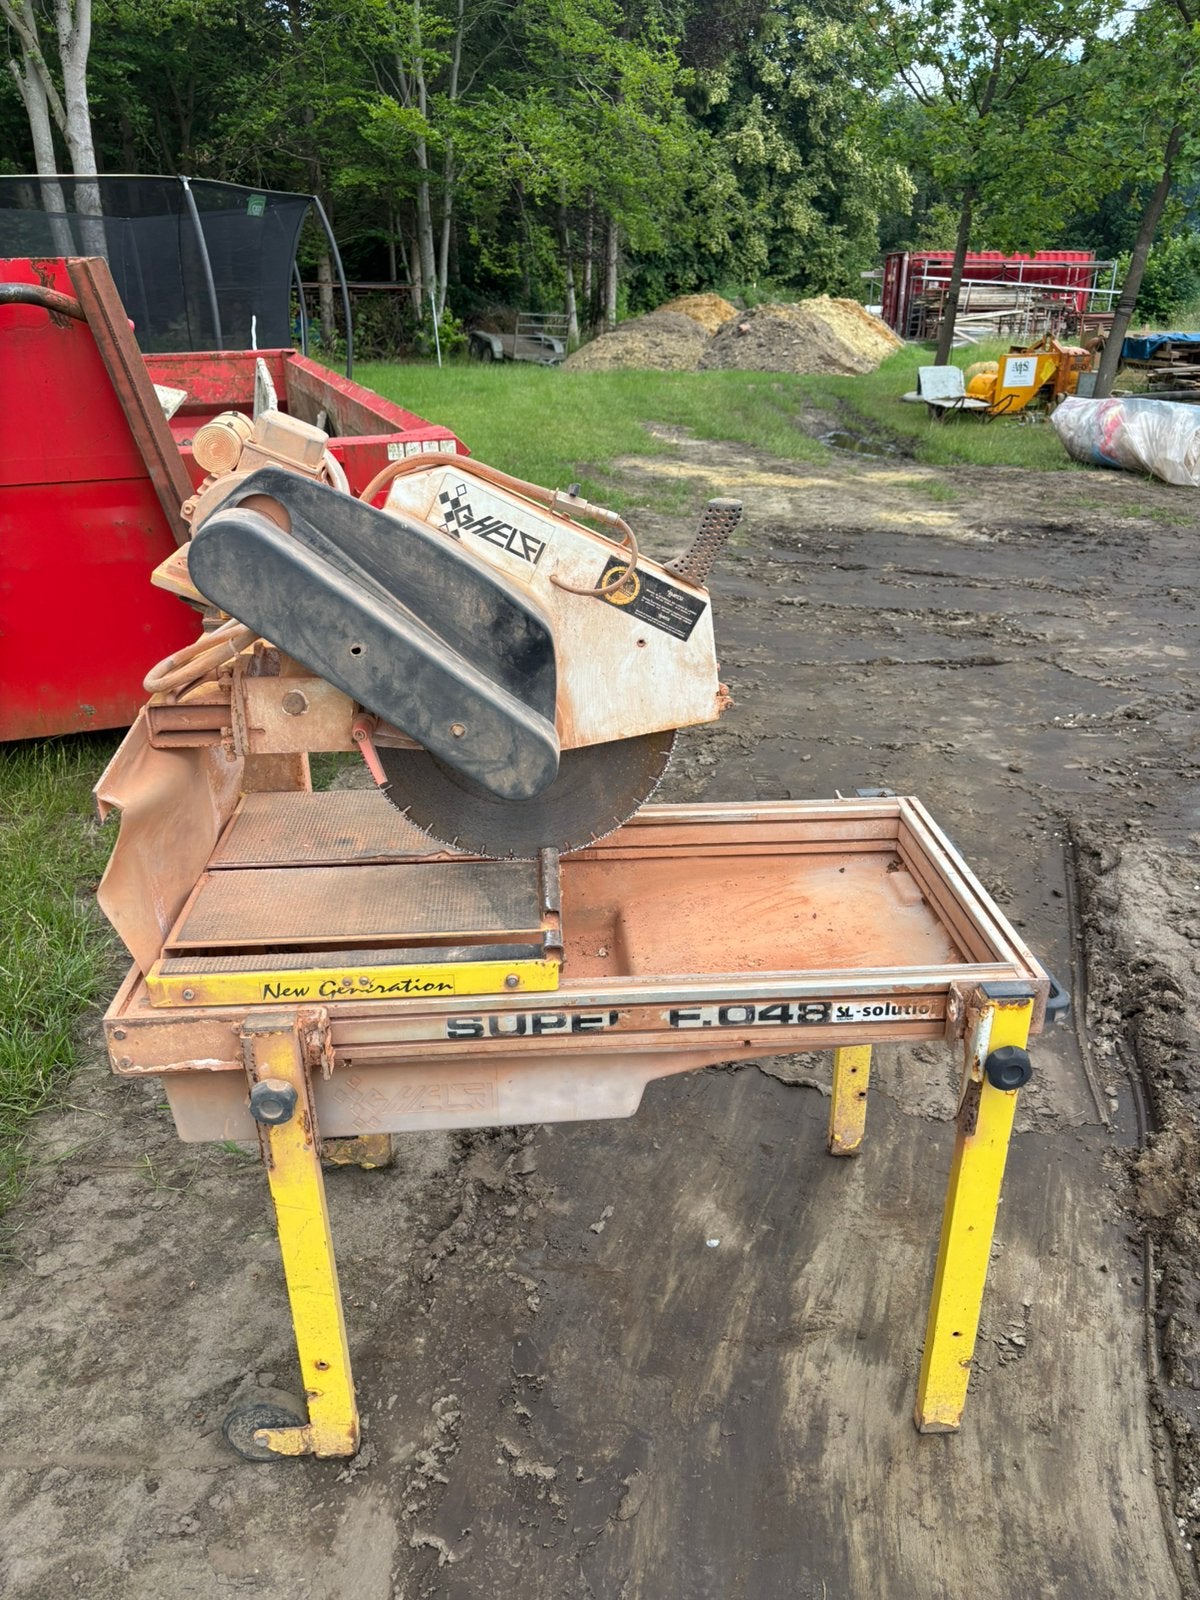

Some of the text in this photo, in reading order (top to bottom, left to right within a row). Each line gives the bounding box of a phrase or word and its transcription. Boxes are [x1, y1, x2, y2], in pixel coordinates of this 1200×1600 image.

[453, 503, 547, 565] GHELFI
[263, 983, 310, 1000] New
[447, 1010, 619, 1039] SUPE
